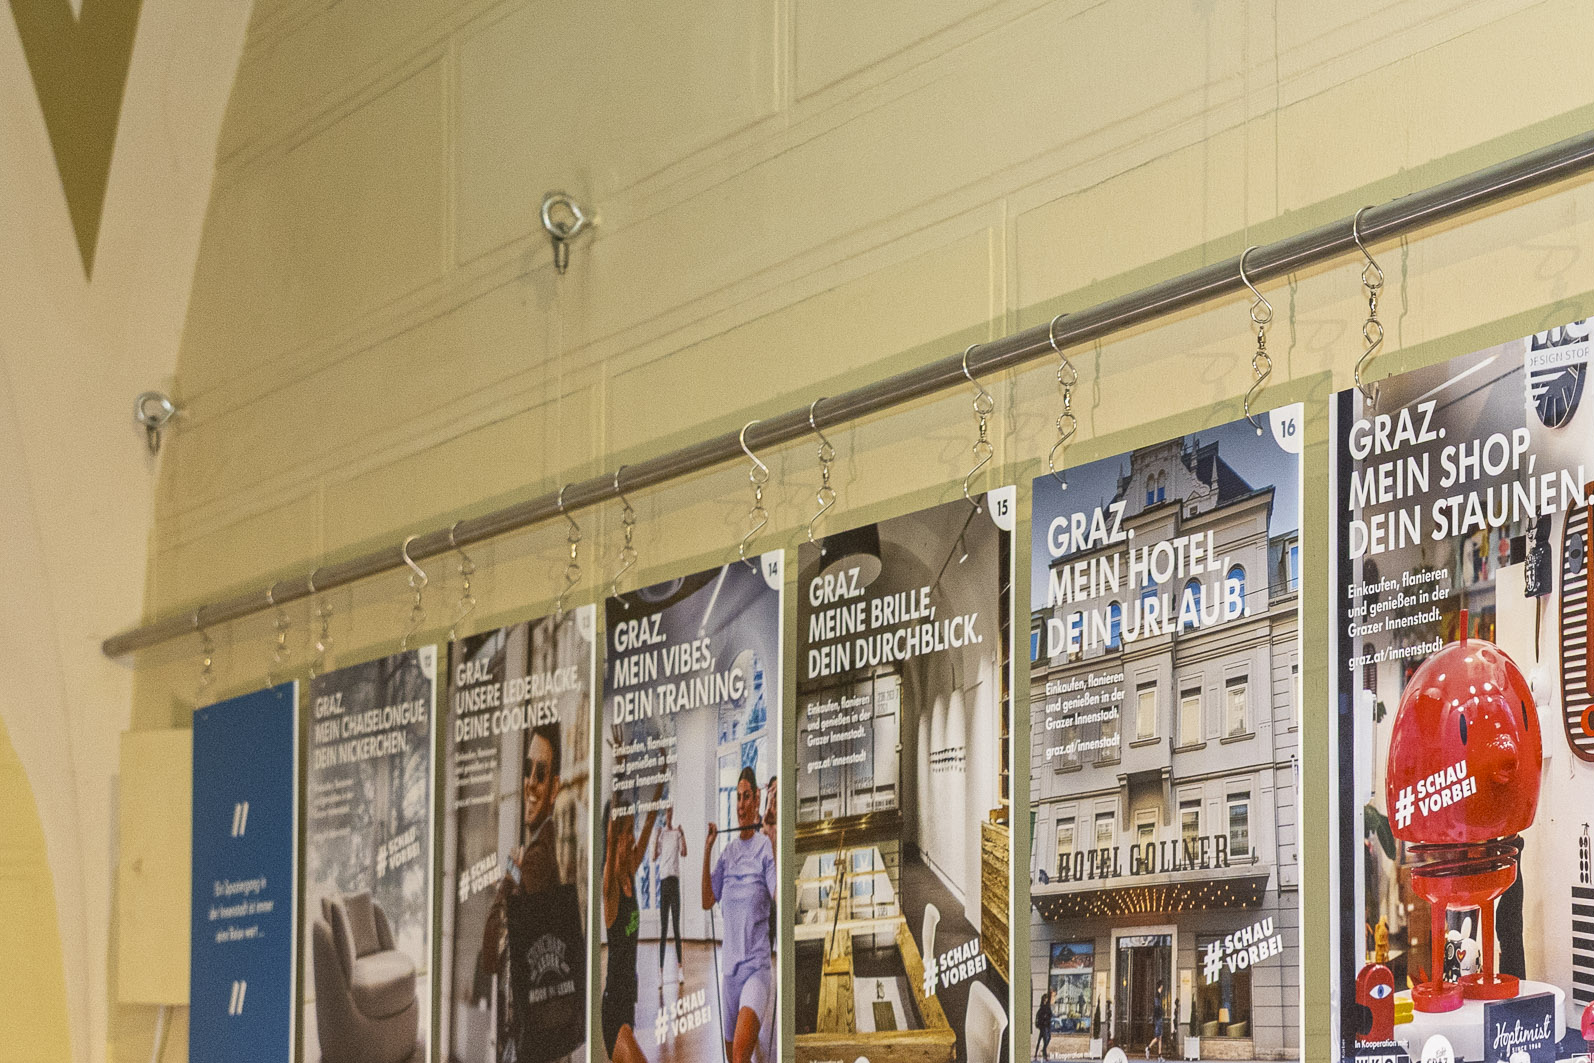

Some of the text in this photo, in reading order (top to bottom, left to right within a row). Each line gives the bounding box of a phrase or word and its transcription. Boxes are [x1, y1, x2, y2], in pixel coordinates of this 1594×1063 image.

[1280, 418, 1296, 437] 16
[1349, 400, 1446, 460] GRAZ.
[1349, 427, 1538, 511] MEIN SHOP,
[997, 499, 1008, 516] 15
[1048, 500, 1134, 557] GRAZ.
[1349, 505, 1422, 560] DEIN
[768, 561, 777, 576] 14
[809, 567, 865, 607] GRAZ.
[1049, 530, 1229, 609] MEIN HOTEL,
[614, 613, 666, 652] GRAZ.
[809, 586, 936, 643] MEINE BRILLE,
[1047, 579, 1250, 658] DEIN URLAUB.
[614, 637, 716, 690] MEIN VIBES,
[809, 613, 983, 679] DEIN DURCHBLICK.
[455, 665, 582, 715] UNSERE LEDERJACKE,
[456, 657, 493, 687] GRAZ.
[614, 668, 748, 725] DEIN TRAINING.
[315, 692, 345, 719] GRAZ.
[455, 700, 562, 743] DEINE COOLNESS.
[315, 719, 340, 745] MEIN
[315, 745, 337, 770] DEIN
[1057, 834, 1231, 883] HOTEL GOLLNER
[1493, 1014, 1551, 1057] Hoptimist
